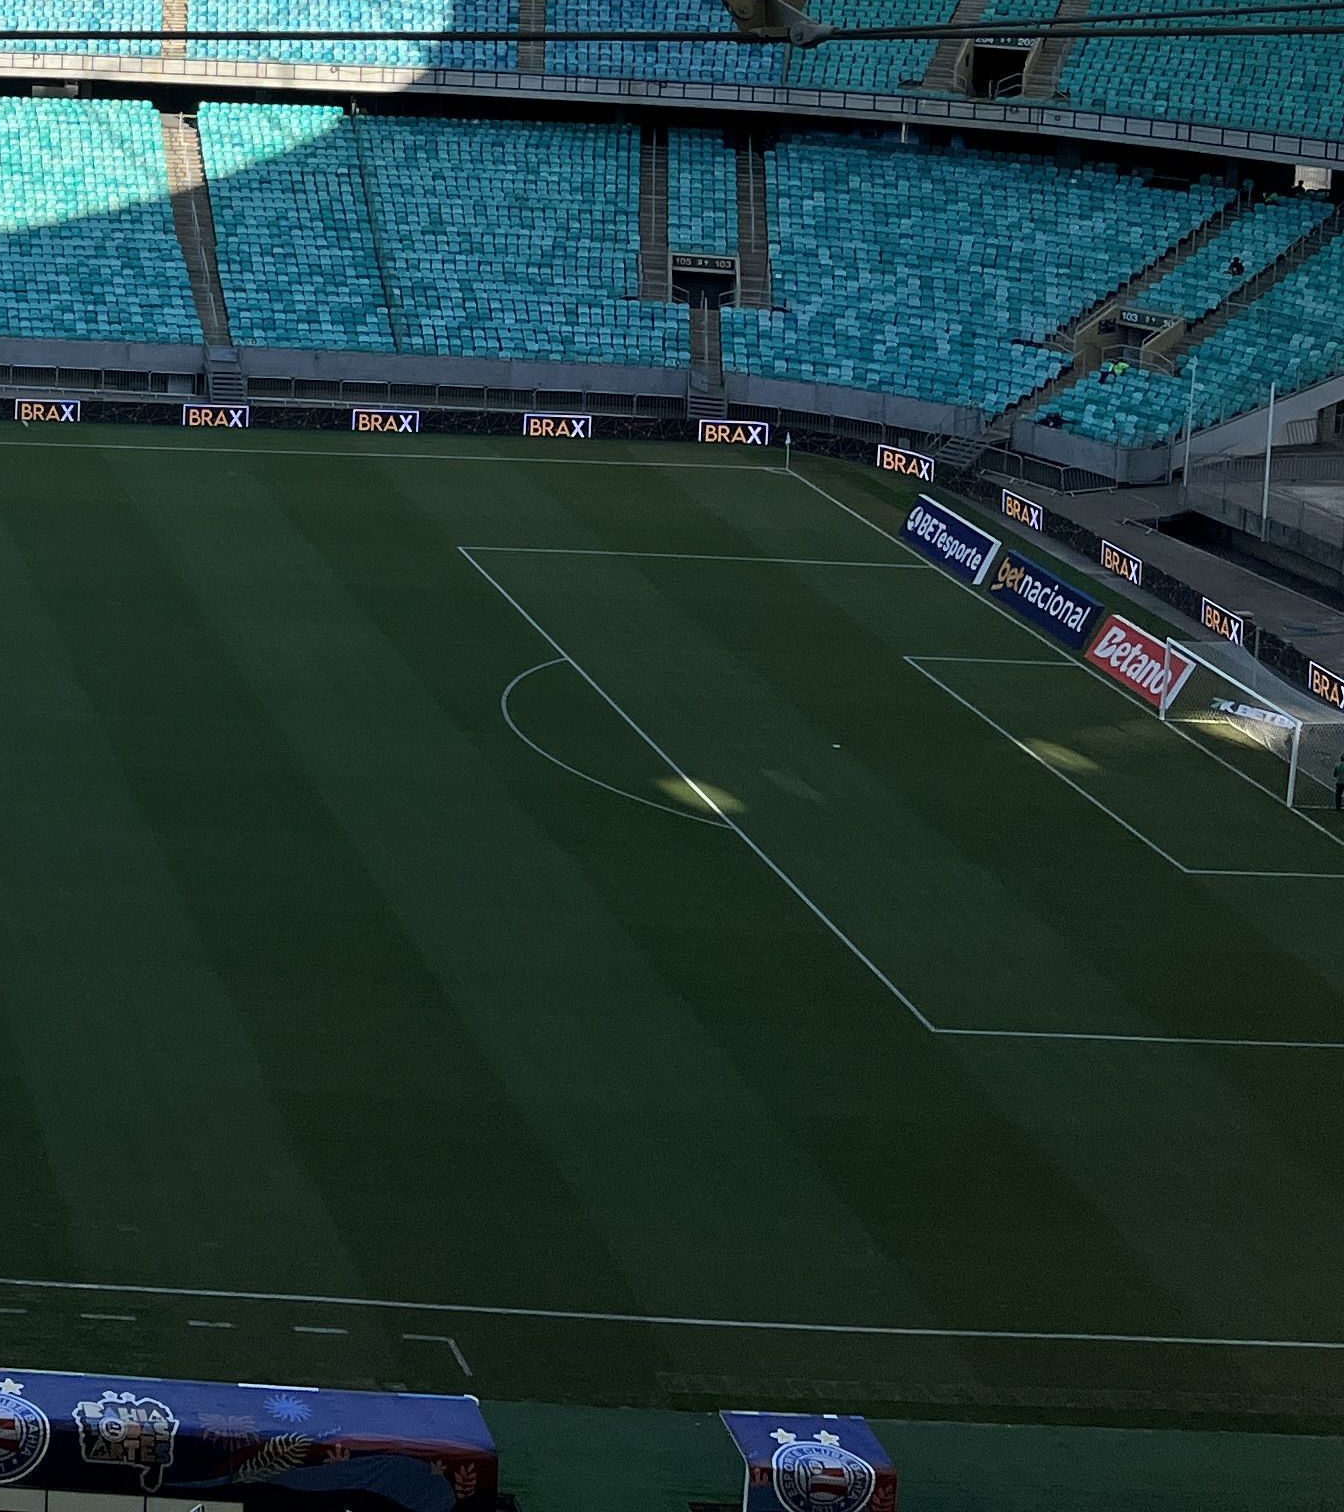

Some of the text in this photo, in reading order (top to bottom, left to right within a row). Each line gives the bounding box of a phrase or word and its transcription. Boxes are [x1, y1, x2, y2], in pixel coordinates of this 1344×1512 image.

[19, 401, 75, 423] BRAX
[187, 407, 245, 428] BRAX
[356, 412, 413, 433] BRAX
[528, 416, 585, 437] BRAX
[703, 423, 763, 444] BRAX
[883, 450, 930, 482] BRAX
[1006, 496, 1040, 530] BRAX
[916, 514, 982, 572] BETesporte
[1105, 546, 1139, 585] BRAX
[997, 556, 1092, 633] betnacional
[1205, 608, 1240, 645] BRAX
[1093, 625, 1173, 695] Betano
